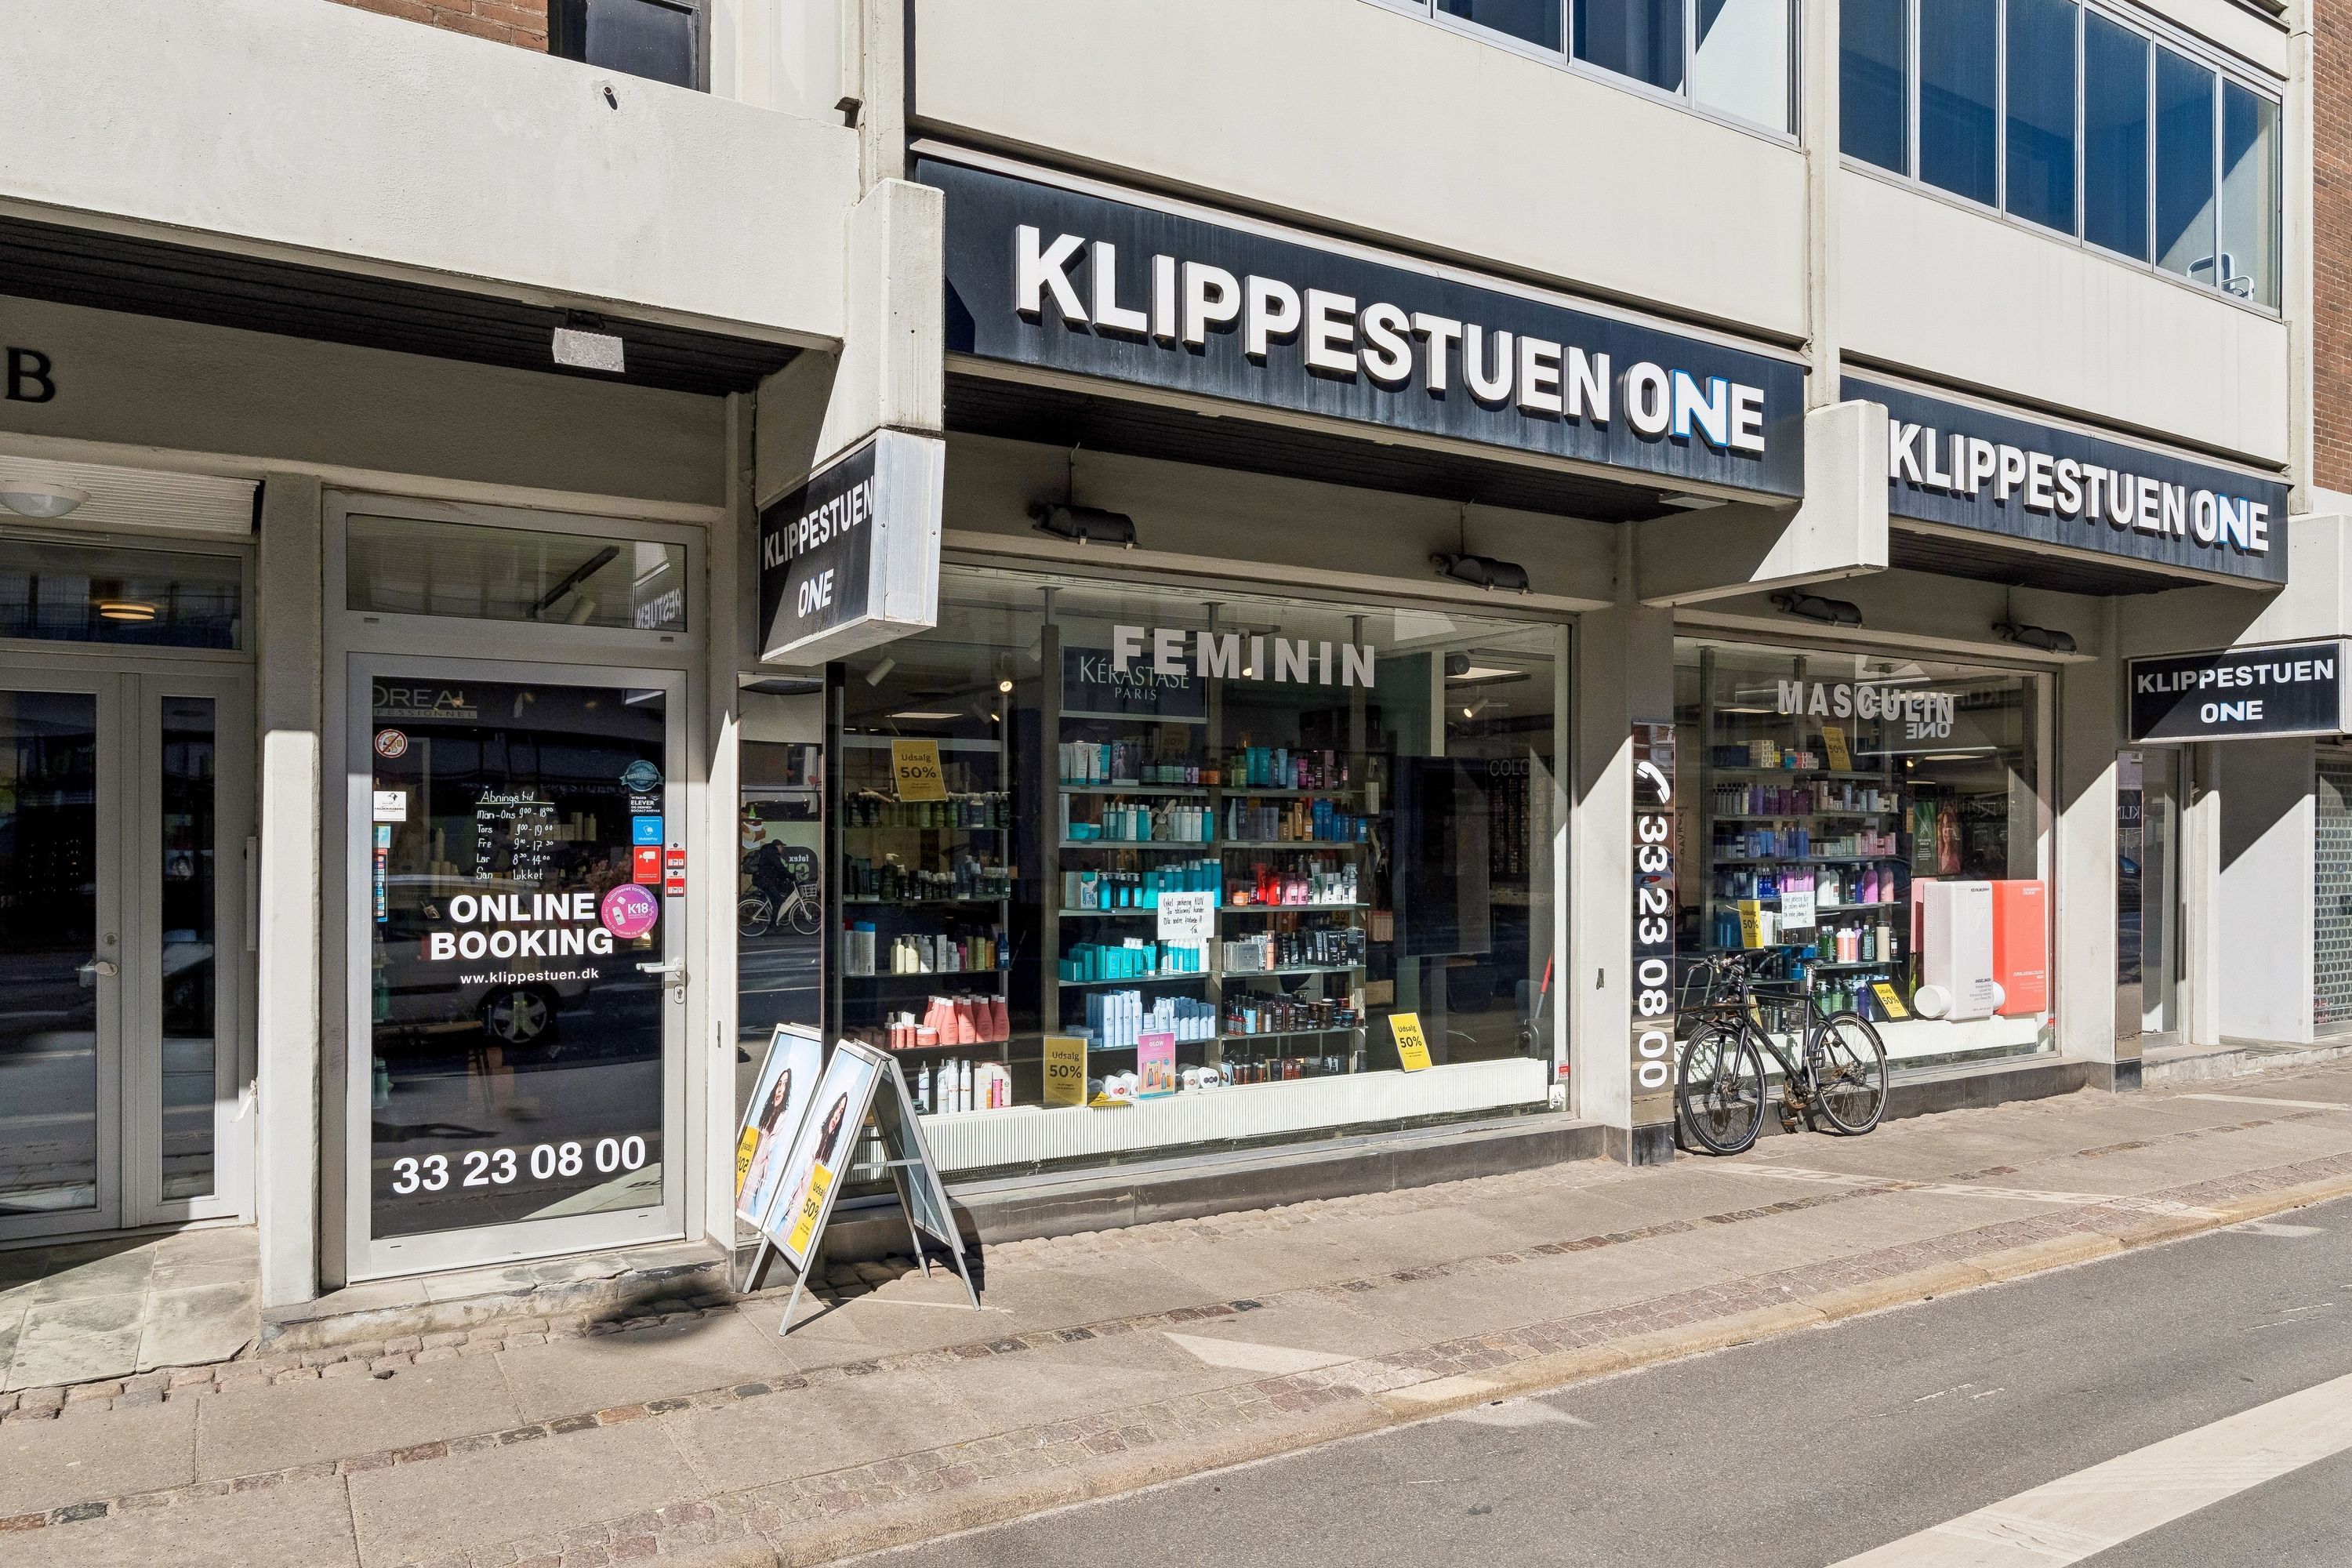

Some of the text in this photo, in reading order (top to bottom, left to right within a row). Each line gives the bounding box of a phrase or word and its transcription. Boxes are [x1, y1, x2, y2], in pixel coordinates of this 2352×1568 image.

[1015, 224, 1765, 452] KLIPPESTUEN ONE
[7, 347, 56, 403] B
[1889, 419, 2270, 552] KLIPPESTUEN ONE
[764, 475, 874, 571] KLIPPESTUEN
[798, 568, 834, 619] ONE
[1113, 625, 1375, 688] FEMININ
[2137, 659, 2334, 695] KLIPPESTUEN
[1115, 687, 1157, 701] PARIS
[1777, 680, 1955, 724] MASCULIN
[2201, 700, 2263, 724] ONE
[902, 753, 931, 763] Udsalg
[900, 766, 937, 779] 50%
[522, 790, 534, 801] tid
[477, 824, 493, 833] Tors
[477, 838, 492, 848] Fre
[513, 868, 543, 880] Lukket
[449, 892, 596, 923] ONLINE
[628, 902, 648, 914] K18
[1743, 920, 1759, 929] 50%
[430, 927, 614, 960] BOOKING
[1639, 815, 1668, 1088] 33 23 08 00
[460, 967, 599, 985] ww.klippestuen.dk
[1882, 996, 1899, 1005] 50%
[1399, 1036, 1422, 1048] 50%
[1052, 1051, 1080, 1062] Udsalg
[1049, 1065, 1082, 1079] 50%
[392, 1135, 646, 1195] 33 23 08 00
[804, 1197, 820, 1221] 50%
